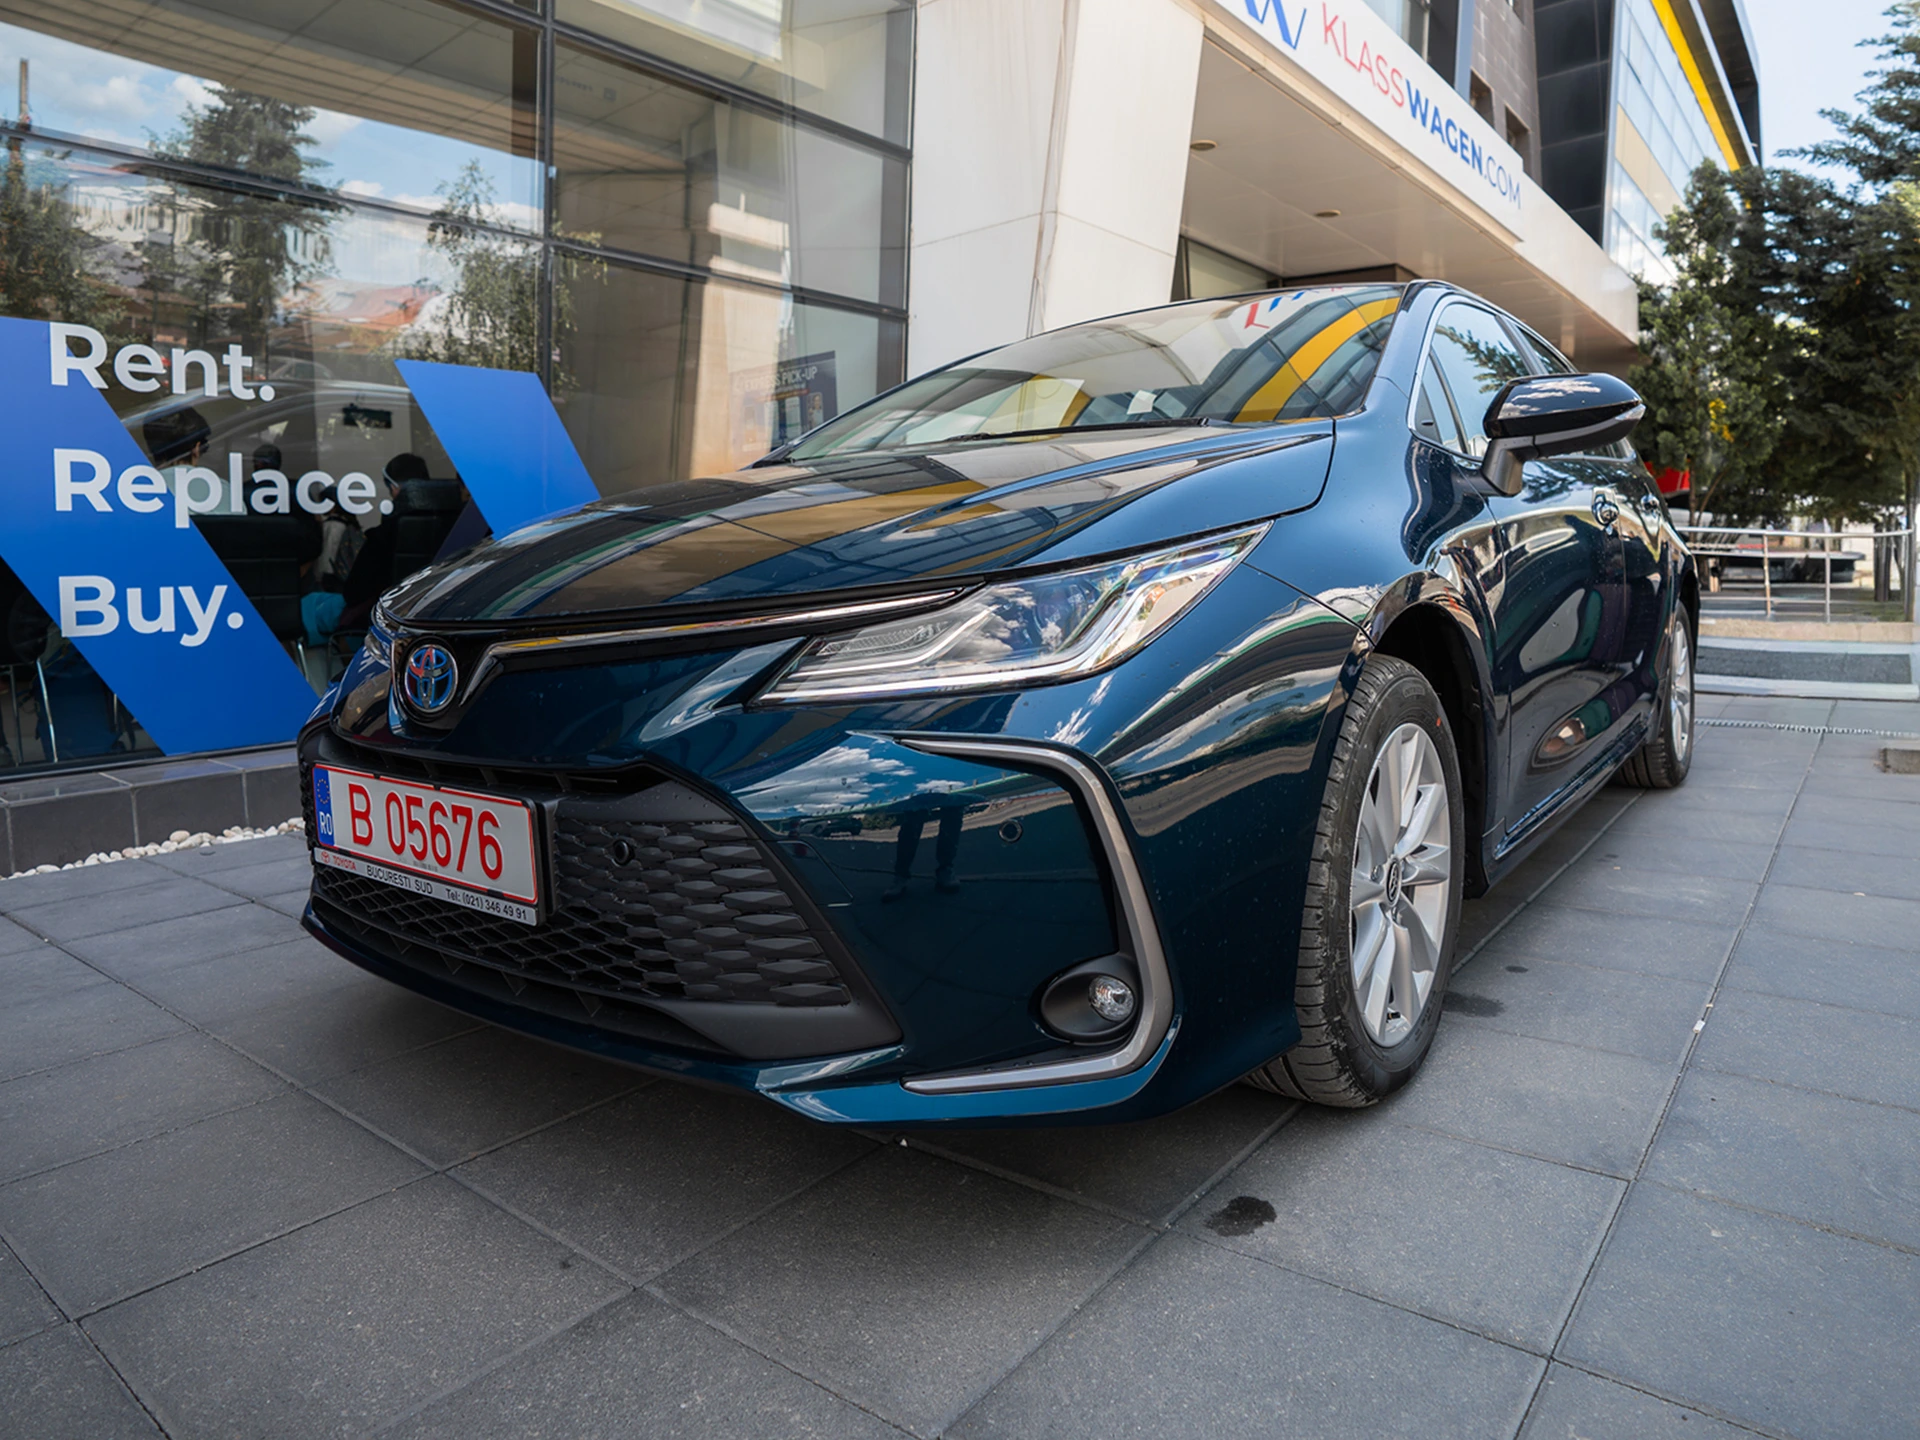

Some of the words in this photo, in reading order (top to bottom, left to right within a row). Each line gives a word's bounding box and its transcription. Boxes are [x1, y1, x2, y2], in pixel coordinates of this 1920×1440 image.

[1322, 2, 1521, 209] KLASSWAGEN.COM
[49, 322, 276, 401] Rent.
[781, 366, 818, 385] PICK-UP
[53, 449, 394, 528] Replace.
[58, 575, 244, 648] Buy.
[319, 811, 333, 835] RO
[348, 783, 374, 847] B
[385, 792, 503, 880] 05676
[332, 855, 356, 871] TOYOTA
[366, 865, 412, 888] BUCURESTI
[414, 880, 433, 895] SUD
[445, 888, 461, 903] Tel:
[462, 891, 483, 910] (021)
[485, 900, 501, 914] 346
[503, 904, 514, 918] 49
[516, 907, 527, 920] 91
